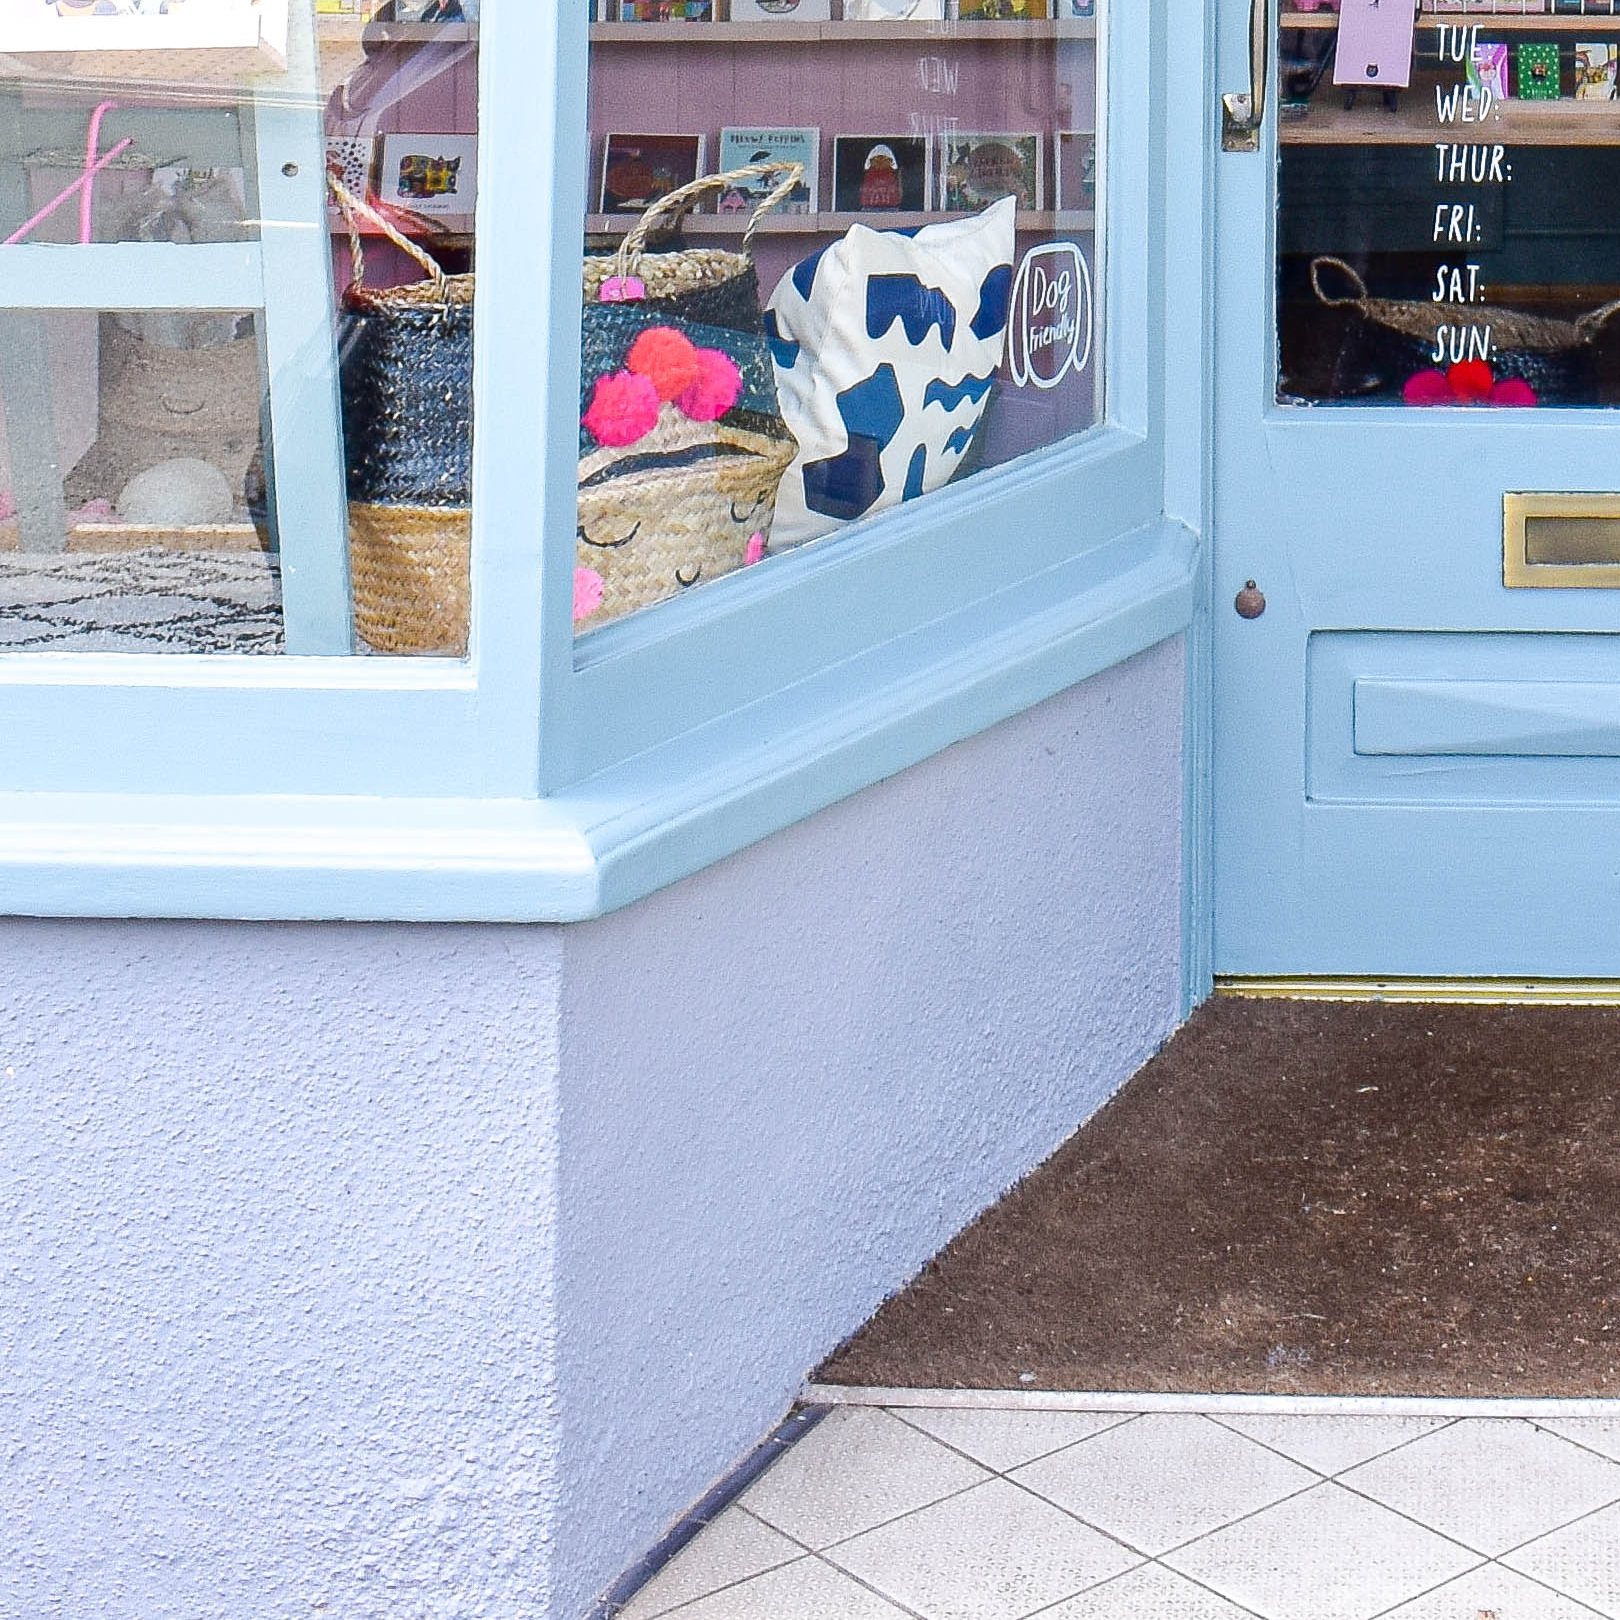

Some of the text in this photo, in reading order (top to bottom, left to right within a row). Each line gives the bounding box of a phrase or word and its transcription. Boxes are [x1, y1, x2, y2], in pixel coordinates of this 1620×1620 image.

[1435, 84, 1500, 123] WED:
[1435, 143, 1512, 183] THUR:
[1433, 204, 1481, 244] FRI:
[1033, 266, 1071, 315] Dog
[1431, 263, 1486, 303] SAT:
[1029, 314, 1075, 354] friendly
[1431, 324, 1498, 363] SUN:
